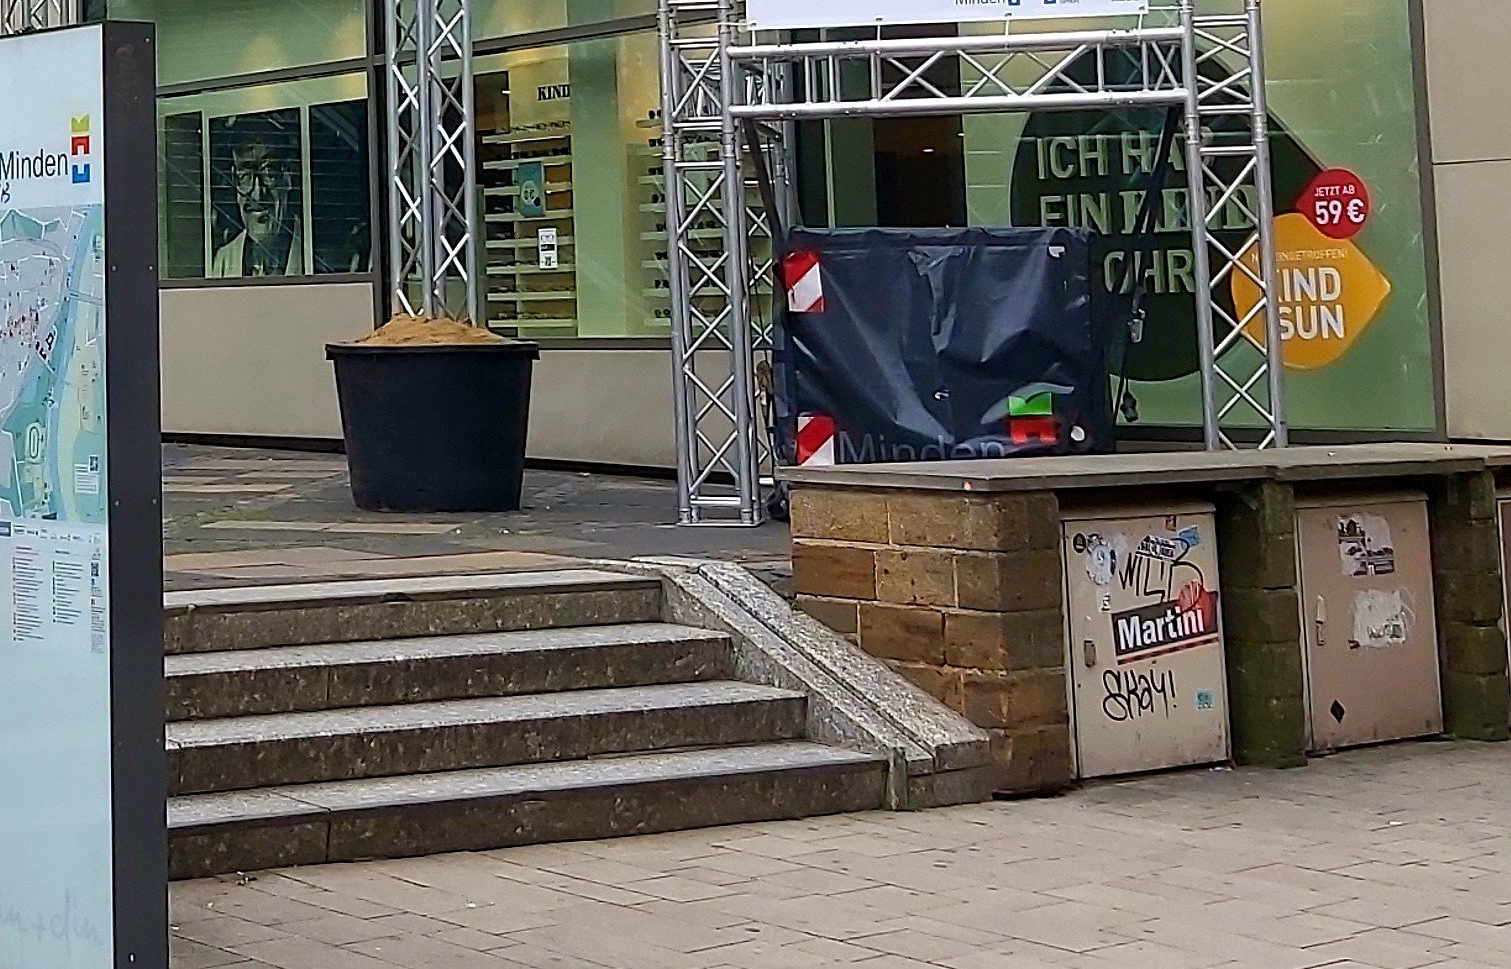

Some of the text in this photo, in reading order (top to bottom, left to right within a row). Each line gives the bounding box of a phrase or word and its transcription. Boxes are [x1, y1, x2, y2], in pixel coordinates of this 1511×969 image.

[1038, 135, 1109, 180] ICH
[1314, 184, 1356, 197] JETZT AB
[1040, 193, 1112, 234] EIN
[1315, 198, 1365, 225] 59 €
[1277, 266, 1342, 303] IND
[1279, 304, 1345, 340] SUN
[839, 431, 1006, 464] Minden
[1117, 606, 1205, 650] Martini
